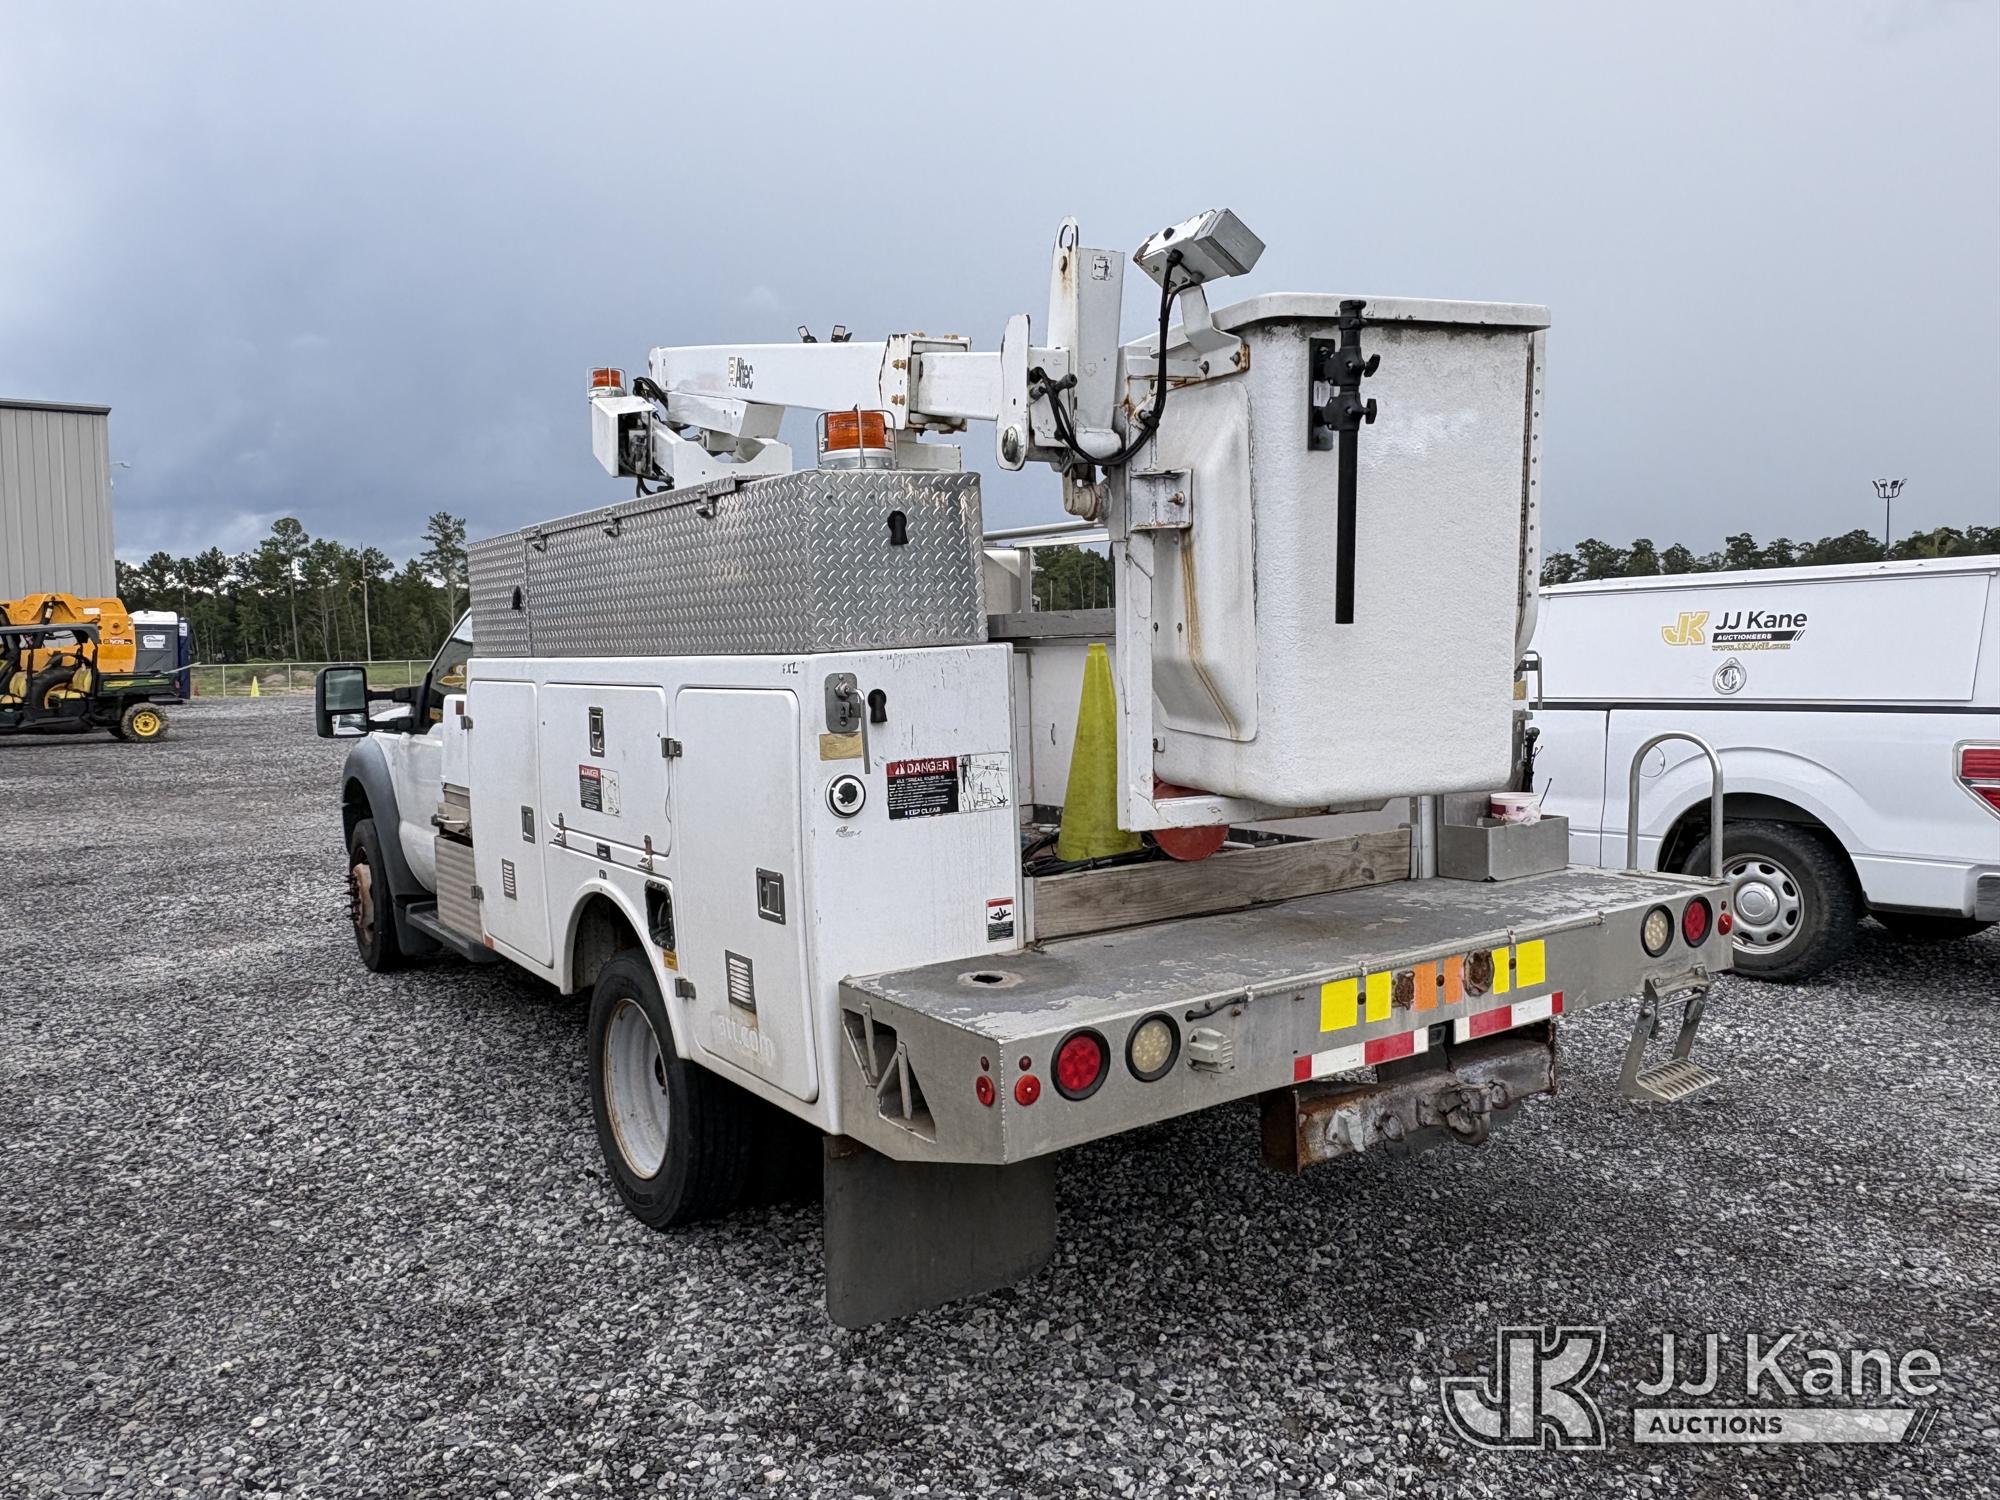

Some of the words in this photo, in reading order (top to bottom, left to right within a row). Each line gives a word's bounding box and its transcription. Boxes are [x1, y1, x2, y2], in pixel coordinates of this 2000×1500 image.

[1715, 612, 1742, 630] JJ
[1747, 611, 1808, 629] Kane
[1716, 633, 1773, 641] AUCTIONEERS
[907, 760, 950, 773] DANGER
[921, 806, 941, 815] CLEAR
